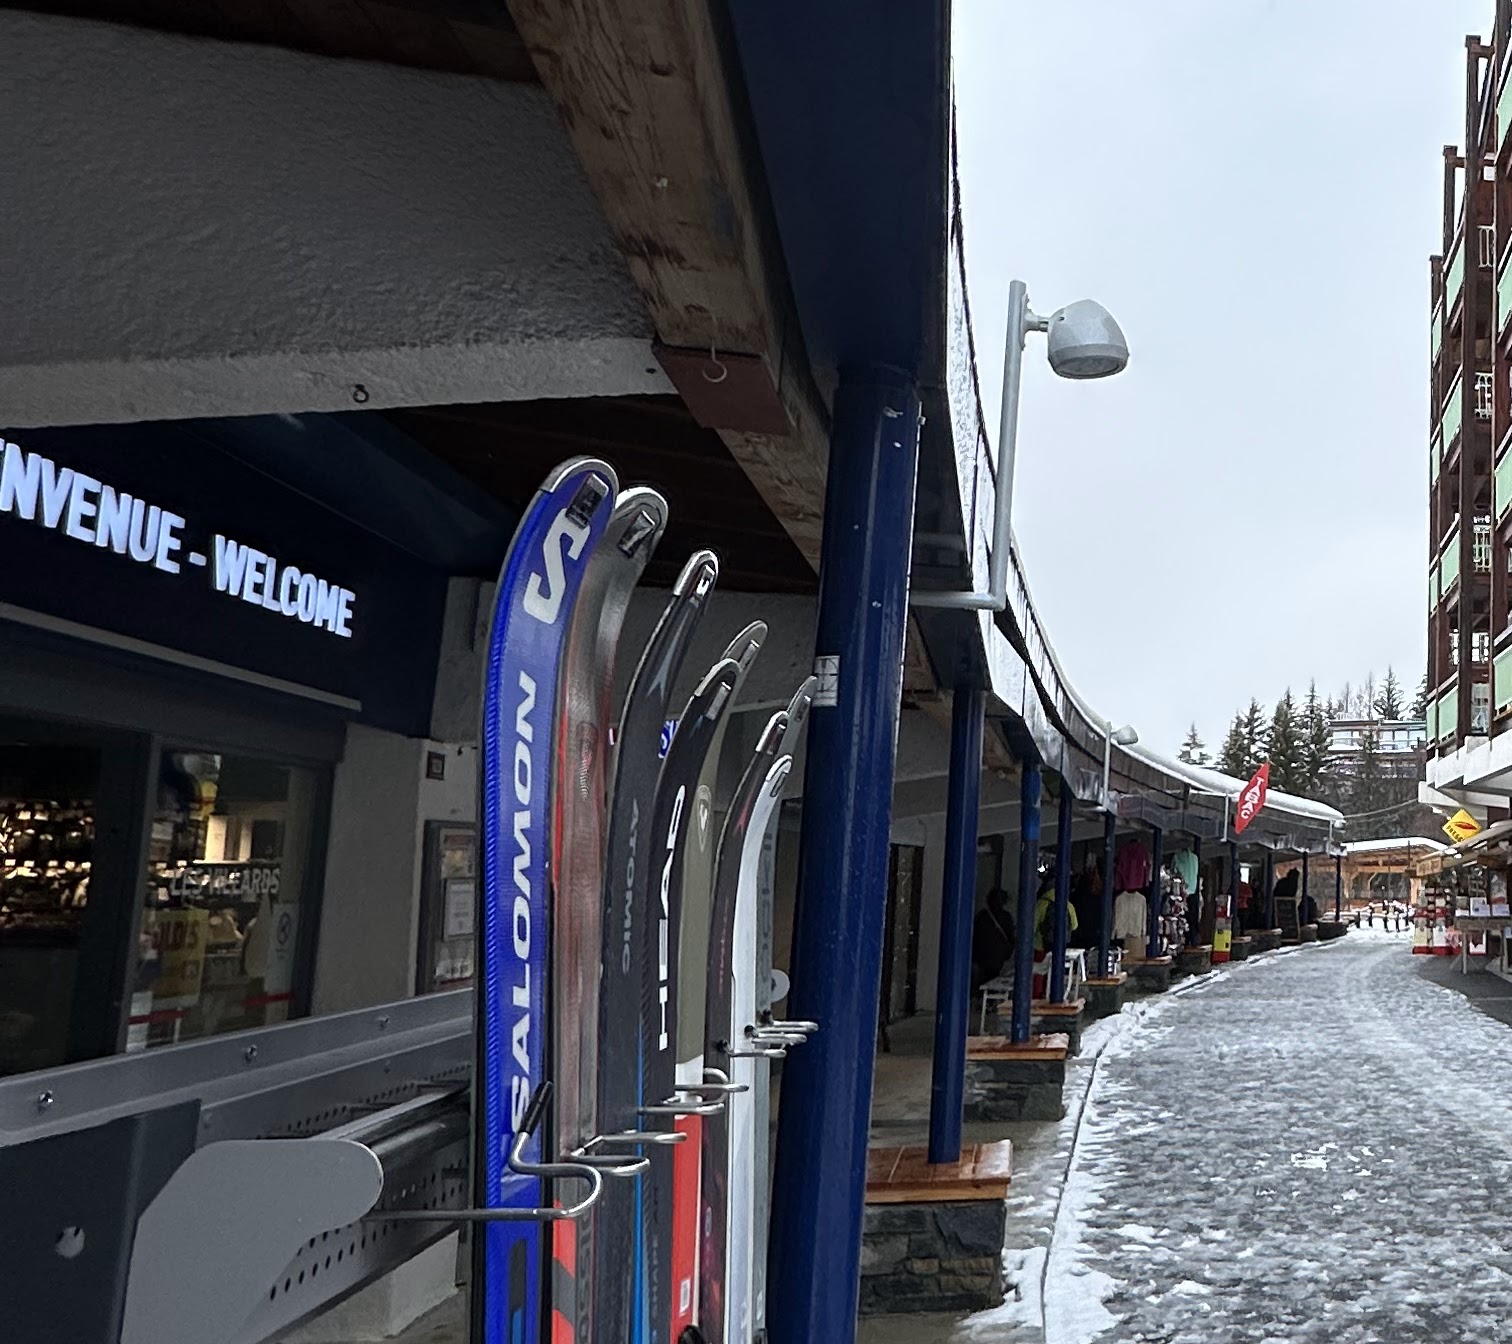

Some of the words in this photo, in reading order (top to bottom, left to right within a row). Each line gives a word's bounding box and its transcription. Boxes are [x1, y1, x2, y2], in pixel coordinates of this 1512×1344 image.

[0, 437, 185, 574] NVENUE
[189, 552, 206, 566] -
[214, 534, 356, 638] WELCOME
[622, 798, 640, 976] ATOMIC
[1240, 776, 1265, 820] TABAC
[1445, 824, 1465, 843] PRESS
[509, 670, 538, 1132] SALOMON
[659, 785, 686, 1052] HEAD
